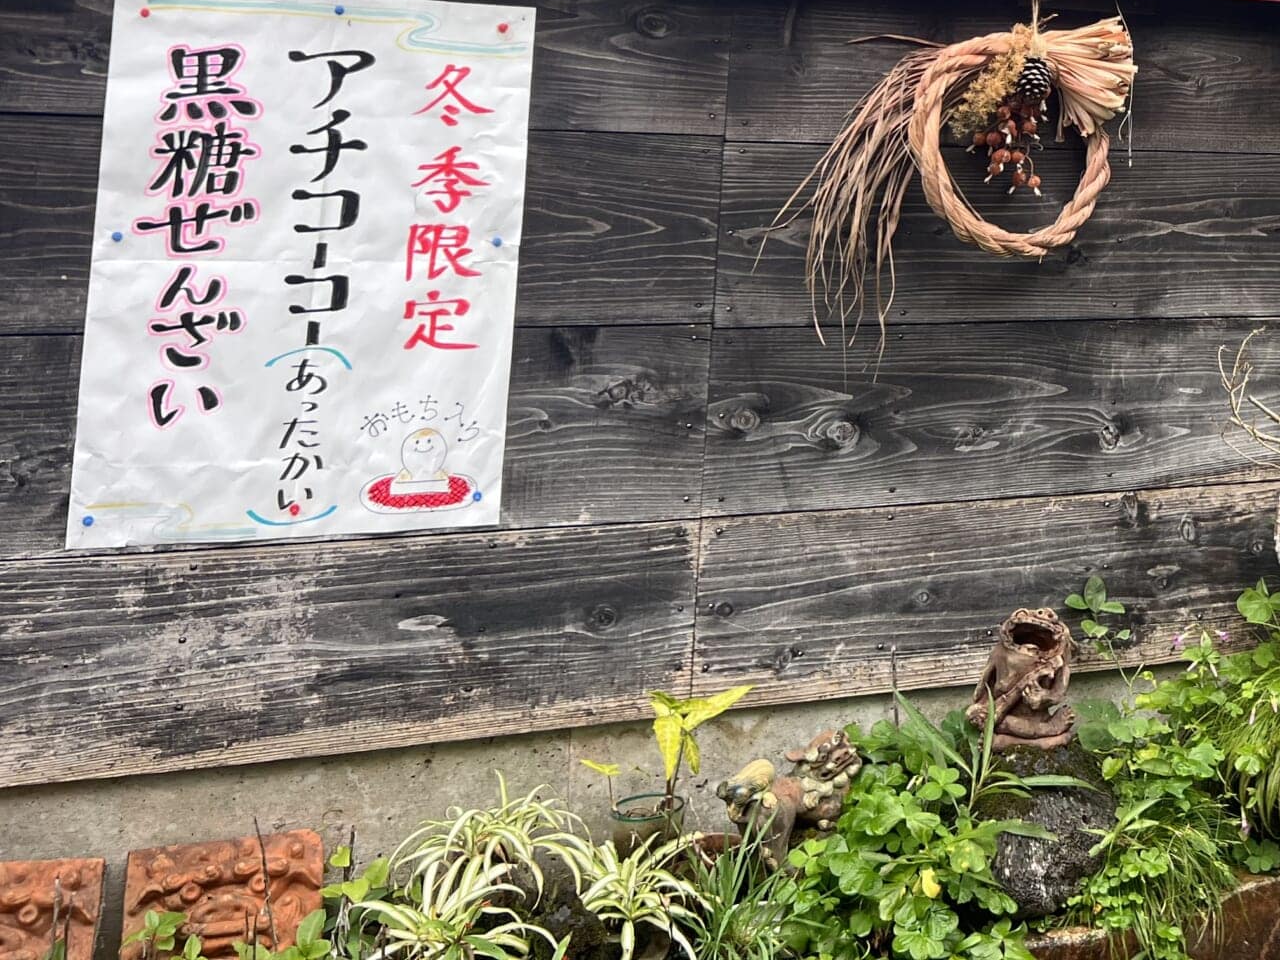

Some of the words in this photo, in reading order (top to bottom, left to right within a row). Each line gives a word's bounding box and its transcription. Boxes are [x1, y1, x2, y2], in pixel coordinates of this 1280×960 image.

[133, 47, 260, 427] 黒糖ぜんざい
[284, 49, 376, 346] アチコーコー
[404, 63, 495, 351] 冬季限定
